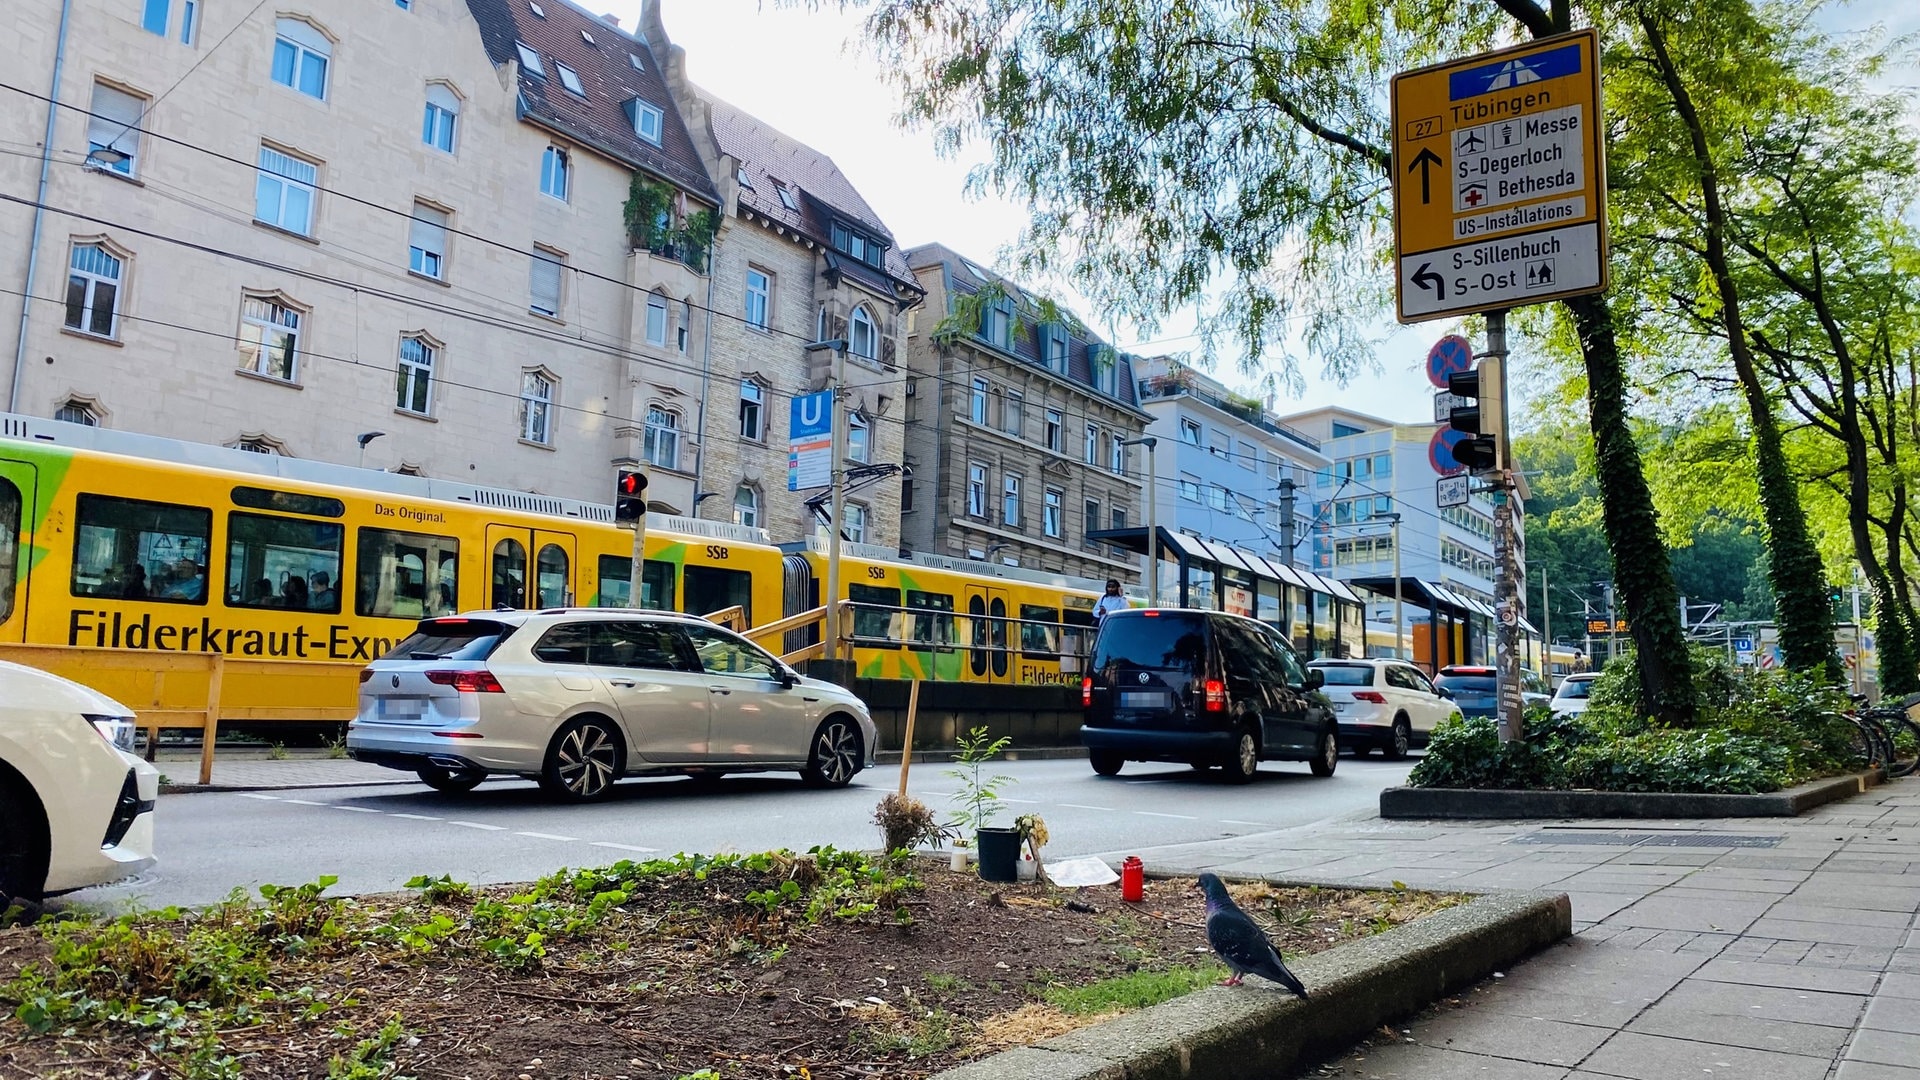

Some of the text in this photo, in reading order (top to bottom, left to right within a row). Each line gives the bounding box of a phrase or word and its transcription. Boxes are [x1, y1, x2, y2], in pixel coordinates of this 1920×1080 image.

[1451, 89, 1550, 123] Tübingen
[1415, 121, 1432, 136] 27
[1526, 116, 1578, 138] Messe
[1459, 144, 1562, 178] S-Degerloch
[1499, 170, 1575, 197] Bethesda
[1459, 204, 1573, 235] US-Installations
[1453, 236, 1560, 270] S-Sillenbuch
[1455, 270, 1517, 295] S-Ost
[801, 395, 822, 426] U
[375, 503, 446, 523] Das Original.
[1320, 504, 1331, 568] HOTE
[706, 545, 729, 560] SSB
[868, 566, 886, 579] SSB
[1739, 640, 1748, 650] U
